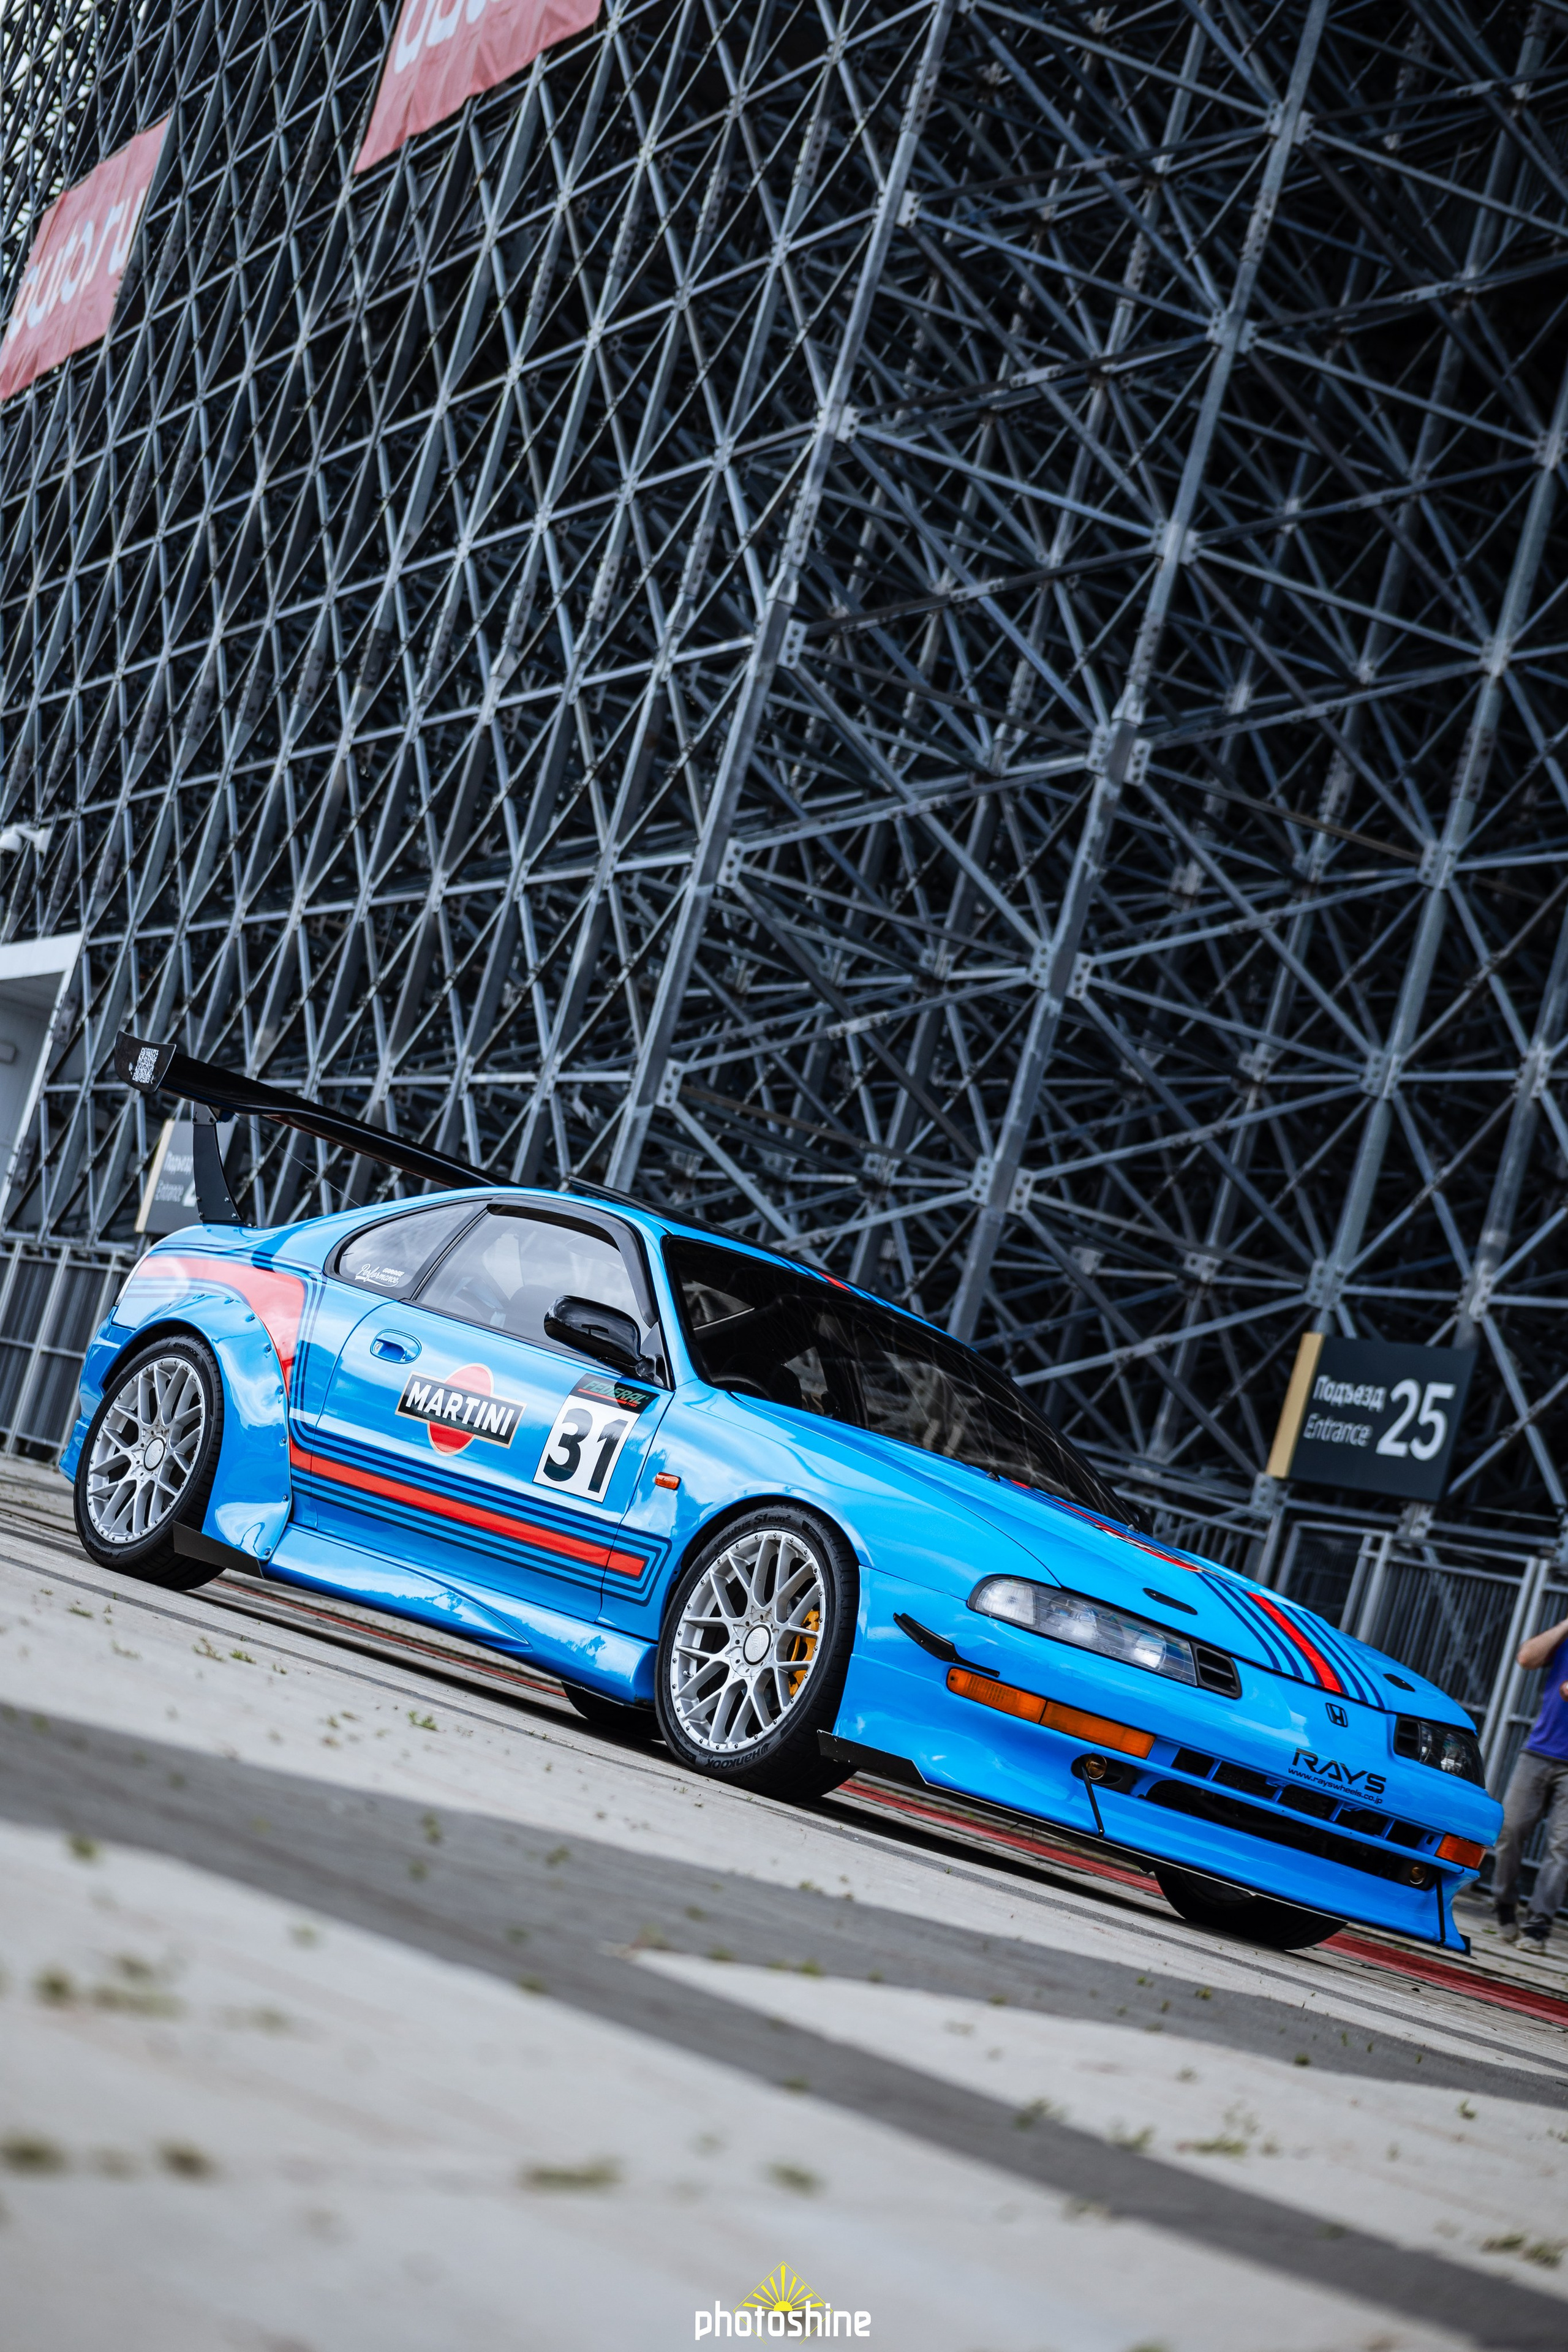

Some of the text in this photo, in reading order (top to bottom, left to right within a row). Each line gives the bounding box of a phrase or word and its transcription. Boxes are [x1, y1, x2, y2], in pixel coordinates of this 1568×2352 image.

[405, 1381, 515, 1436] MARTINI
[582, 1381, 646, 1404] FEDERAL
[1313, 1375, 1387, 1412] Подъезд
[1303, 1413, 1373, 1447] Entrance
[1376, 1378, 1457, 1461] 25
[543, 1408, 628, 1493] 31
[1288, 1768, 1383, 1804] www.rayswheels.co.jp
[1292, 1747, 1386, 1795] RAYS
